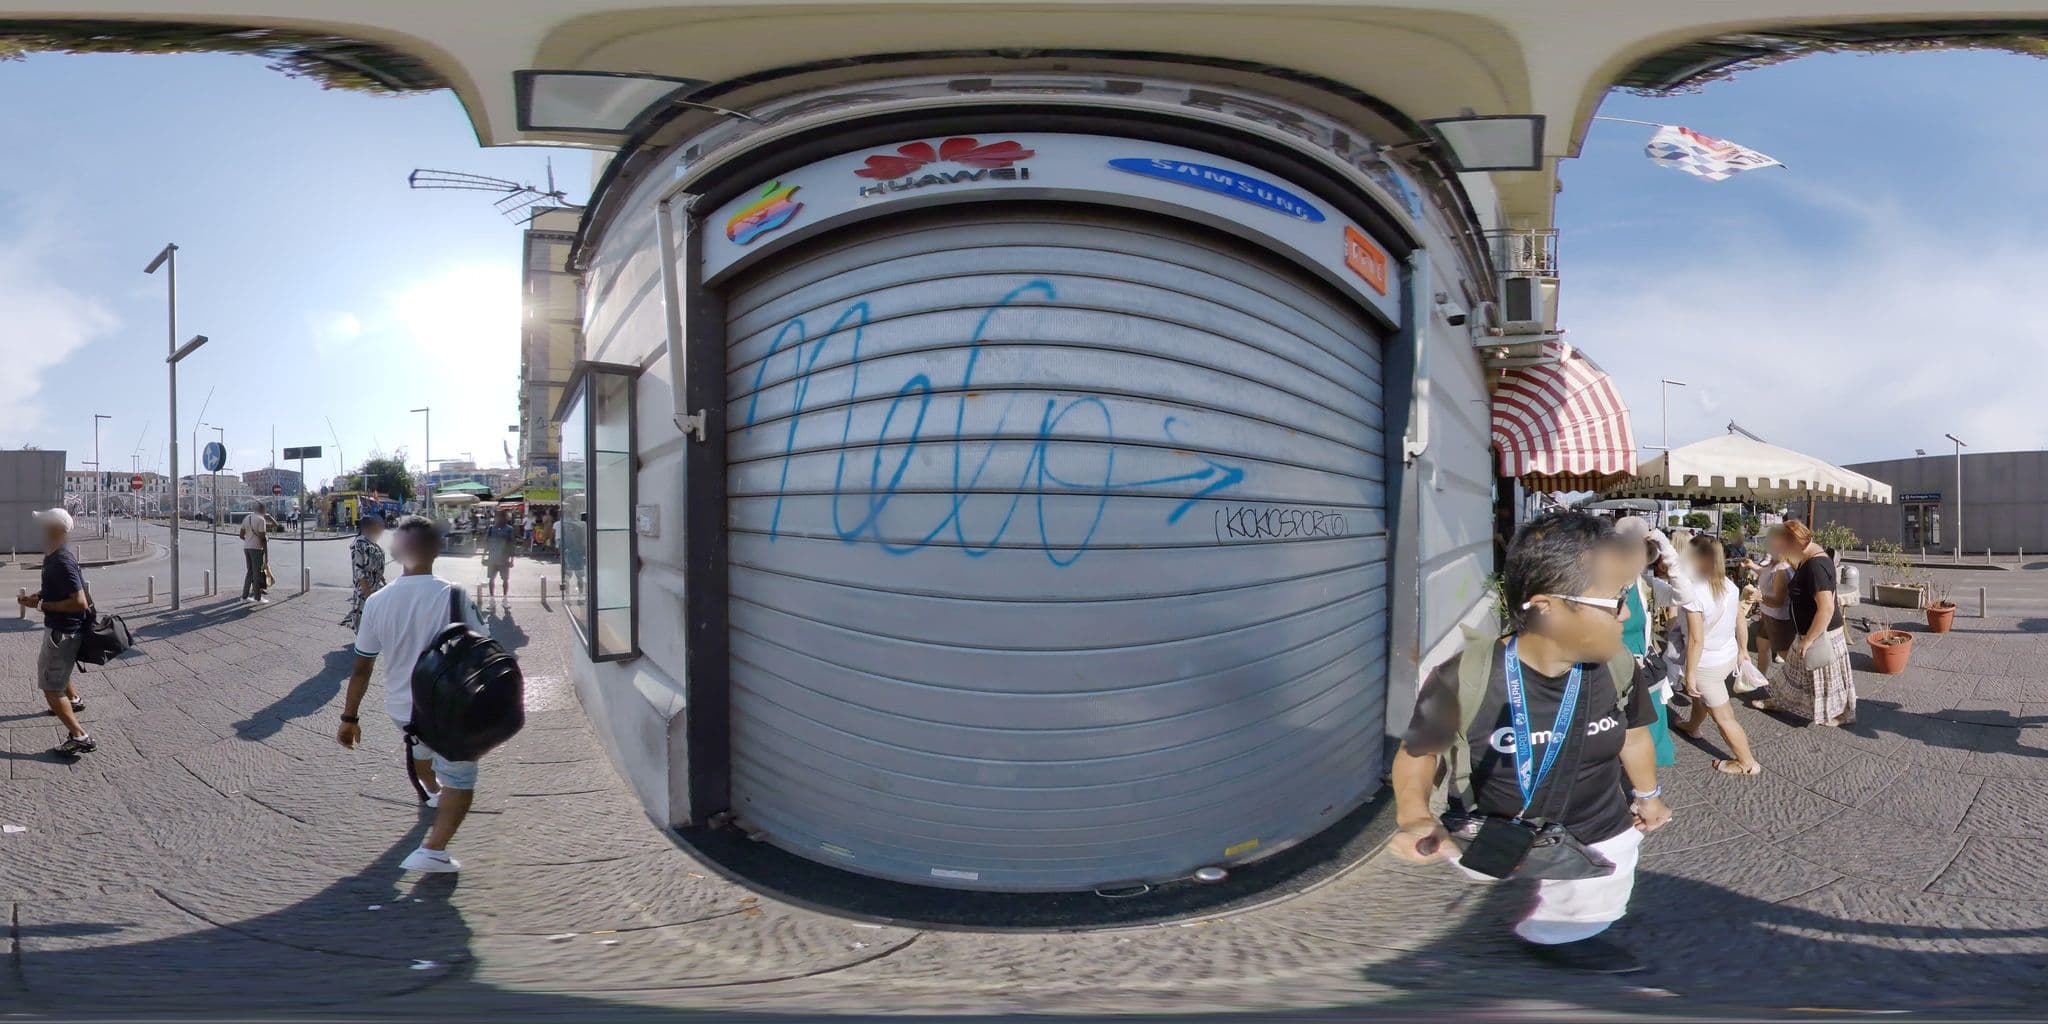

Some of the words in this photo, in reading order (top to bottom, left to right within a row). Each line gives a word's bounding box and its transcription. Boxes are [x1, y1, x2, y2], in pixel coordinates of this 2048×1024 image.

[859, 166, 1030, 198] HUAWEI
[1151, 158, 1310, 221] SAMSUNG
[1558, 684, 1577, 726] RESISTANCE
[1518, 730, 1528, 756] NAPOLI
